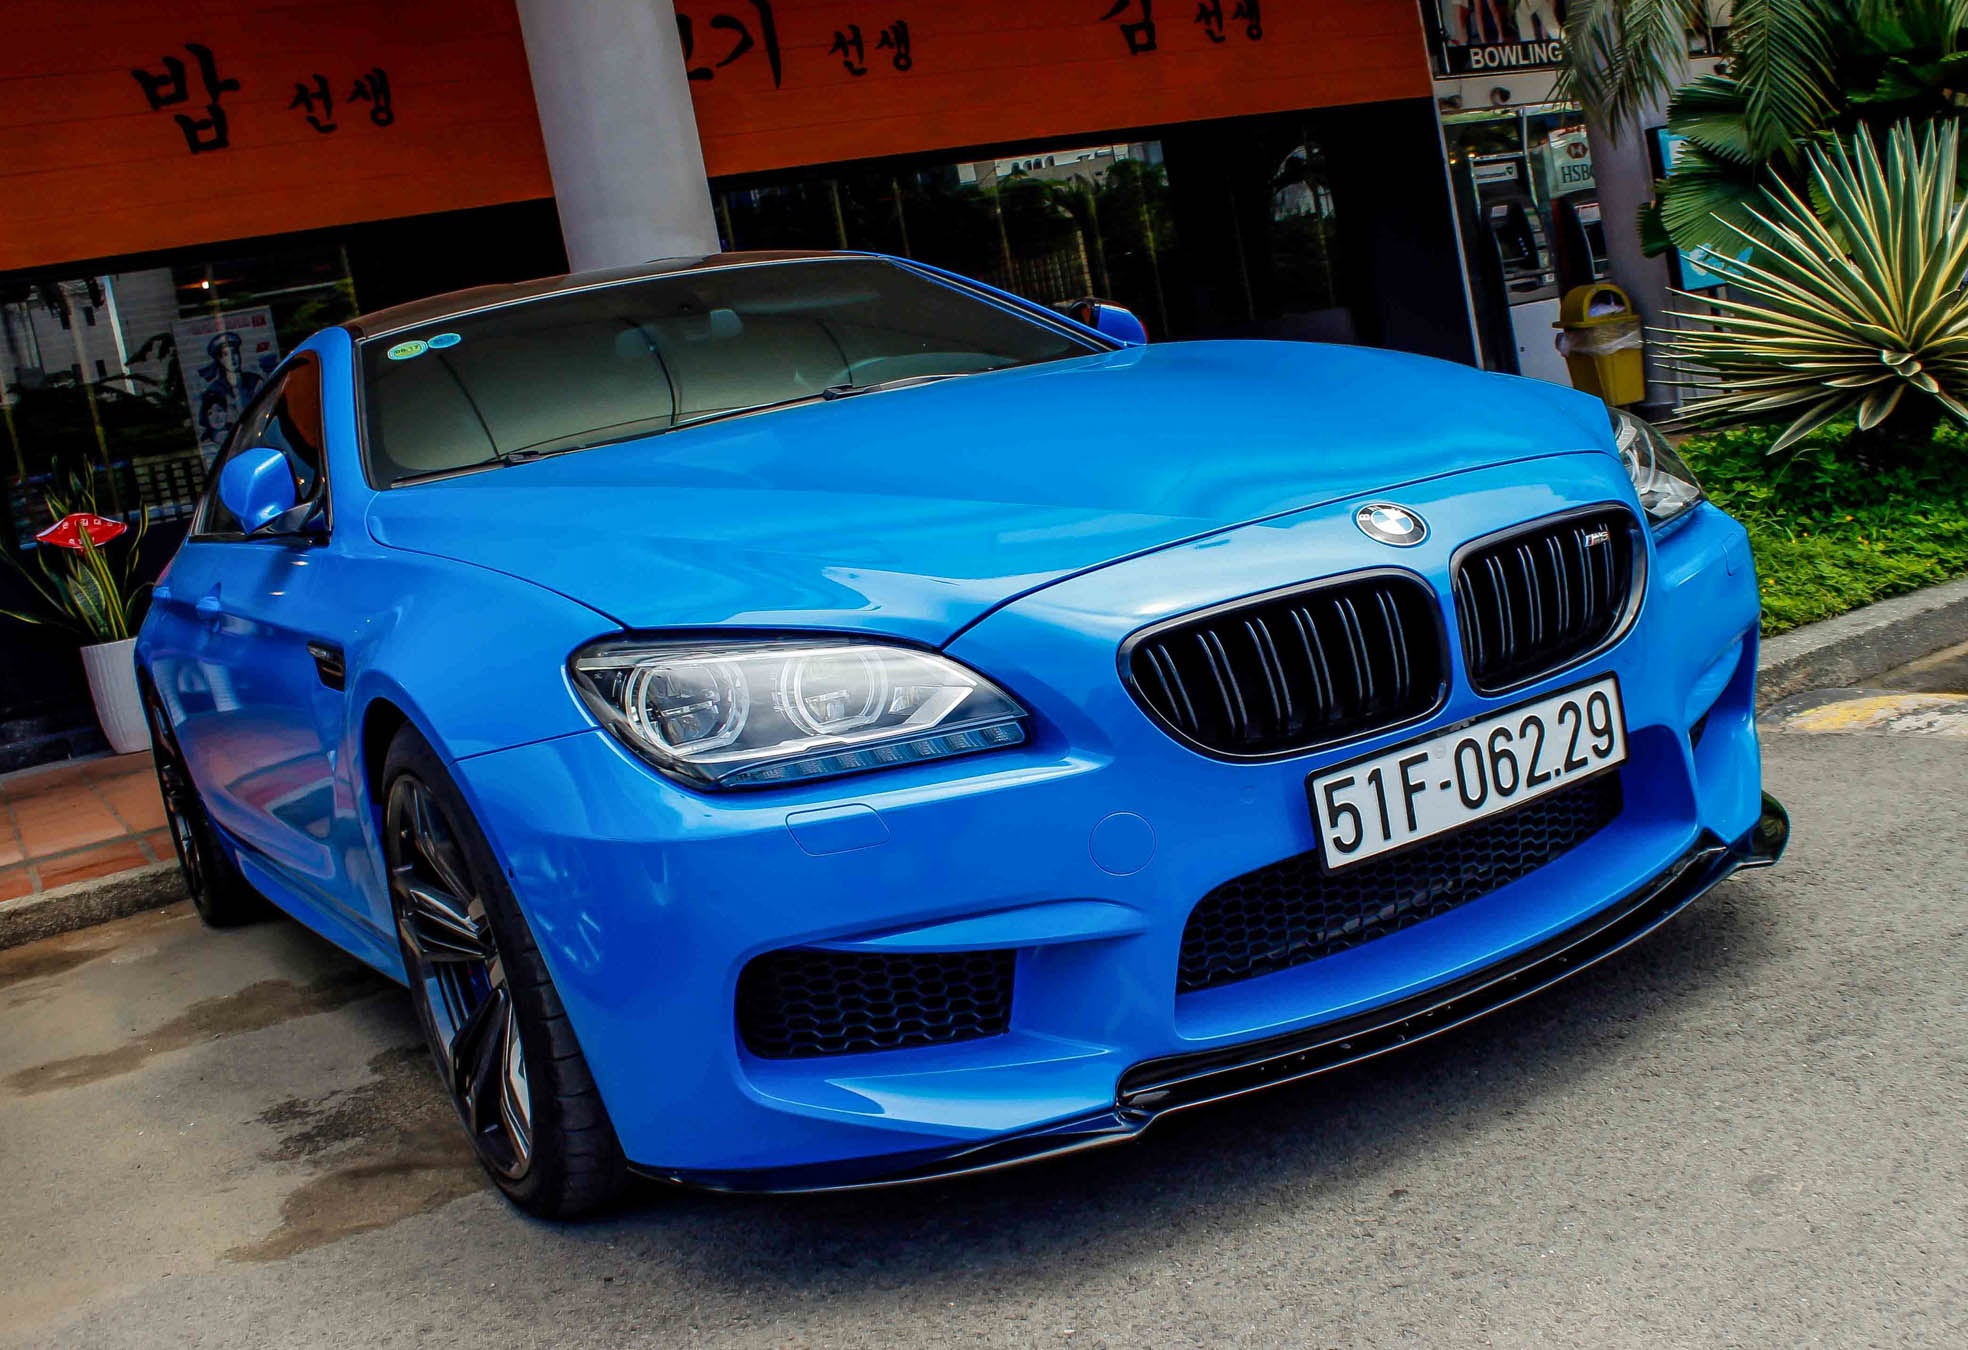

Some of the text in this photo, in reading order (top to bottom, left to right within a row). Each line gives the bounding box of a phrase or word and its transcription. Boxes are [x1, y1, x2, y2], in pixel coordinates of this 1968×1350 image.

[829, 20, 913, 77] 선생
[1470, 42, 1563, 69] BOWLING
[132, 44, 394, 154] 밥 선생
[1323, 690, 1615, 854] 51F-062.29
